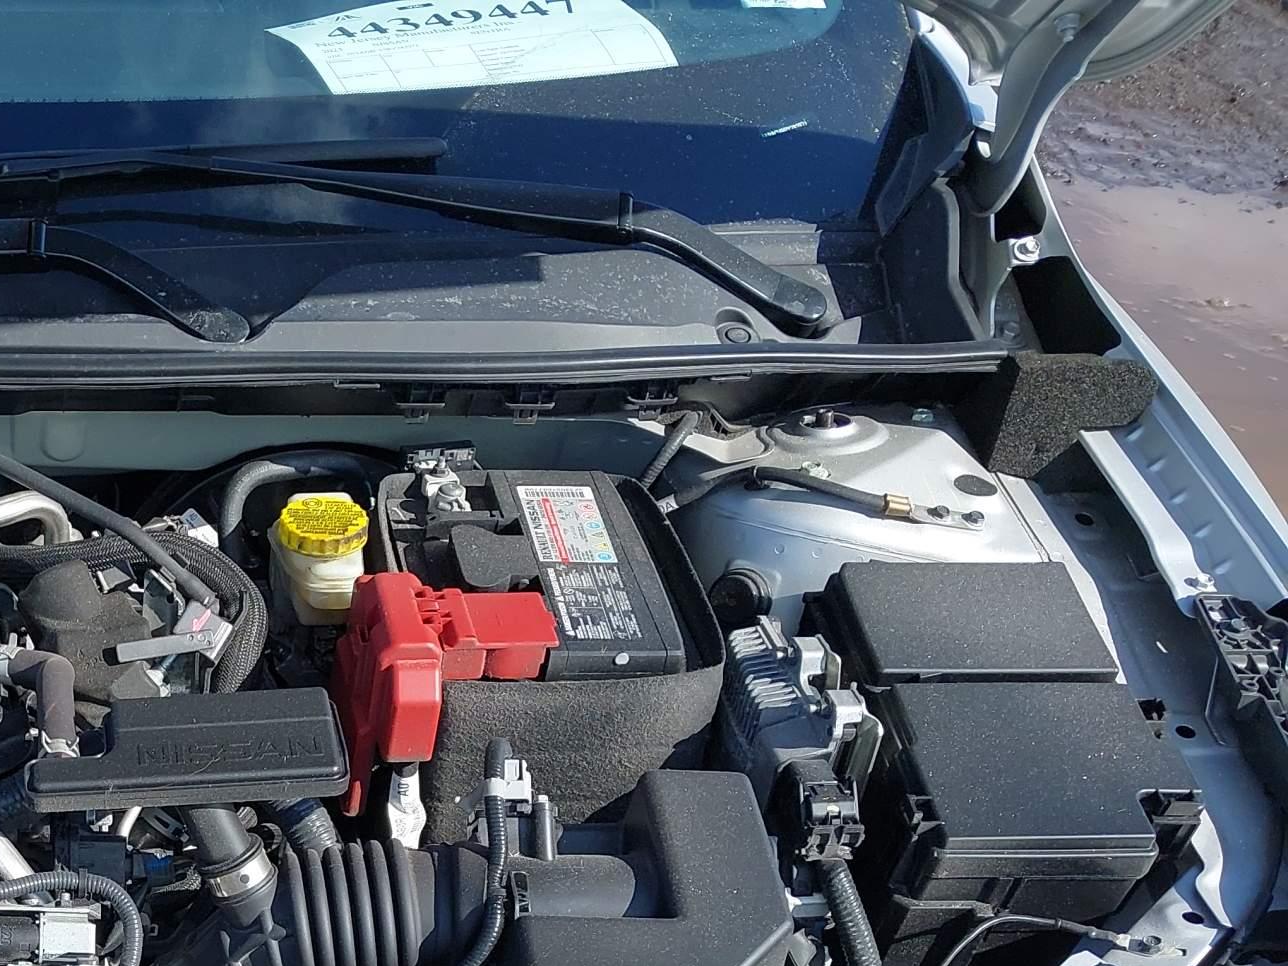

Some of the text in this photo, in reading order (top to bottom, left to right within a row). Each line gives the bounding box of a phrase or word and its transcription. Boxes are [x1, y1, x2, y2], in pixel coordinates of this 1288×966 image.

[328, 0, 573, 38] 44349447
[525, 498, 543, 530] NISSAN
[137, 735, 325, 767] NISSAN
